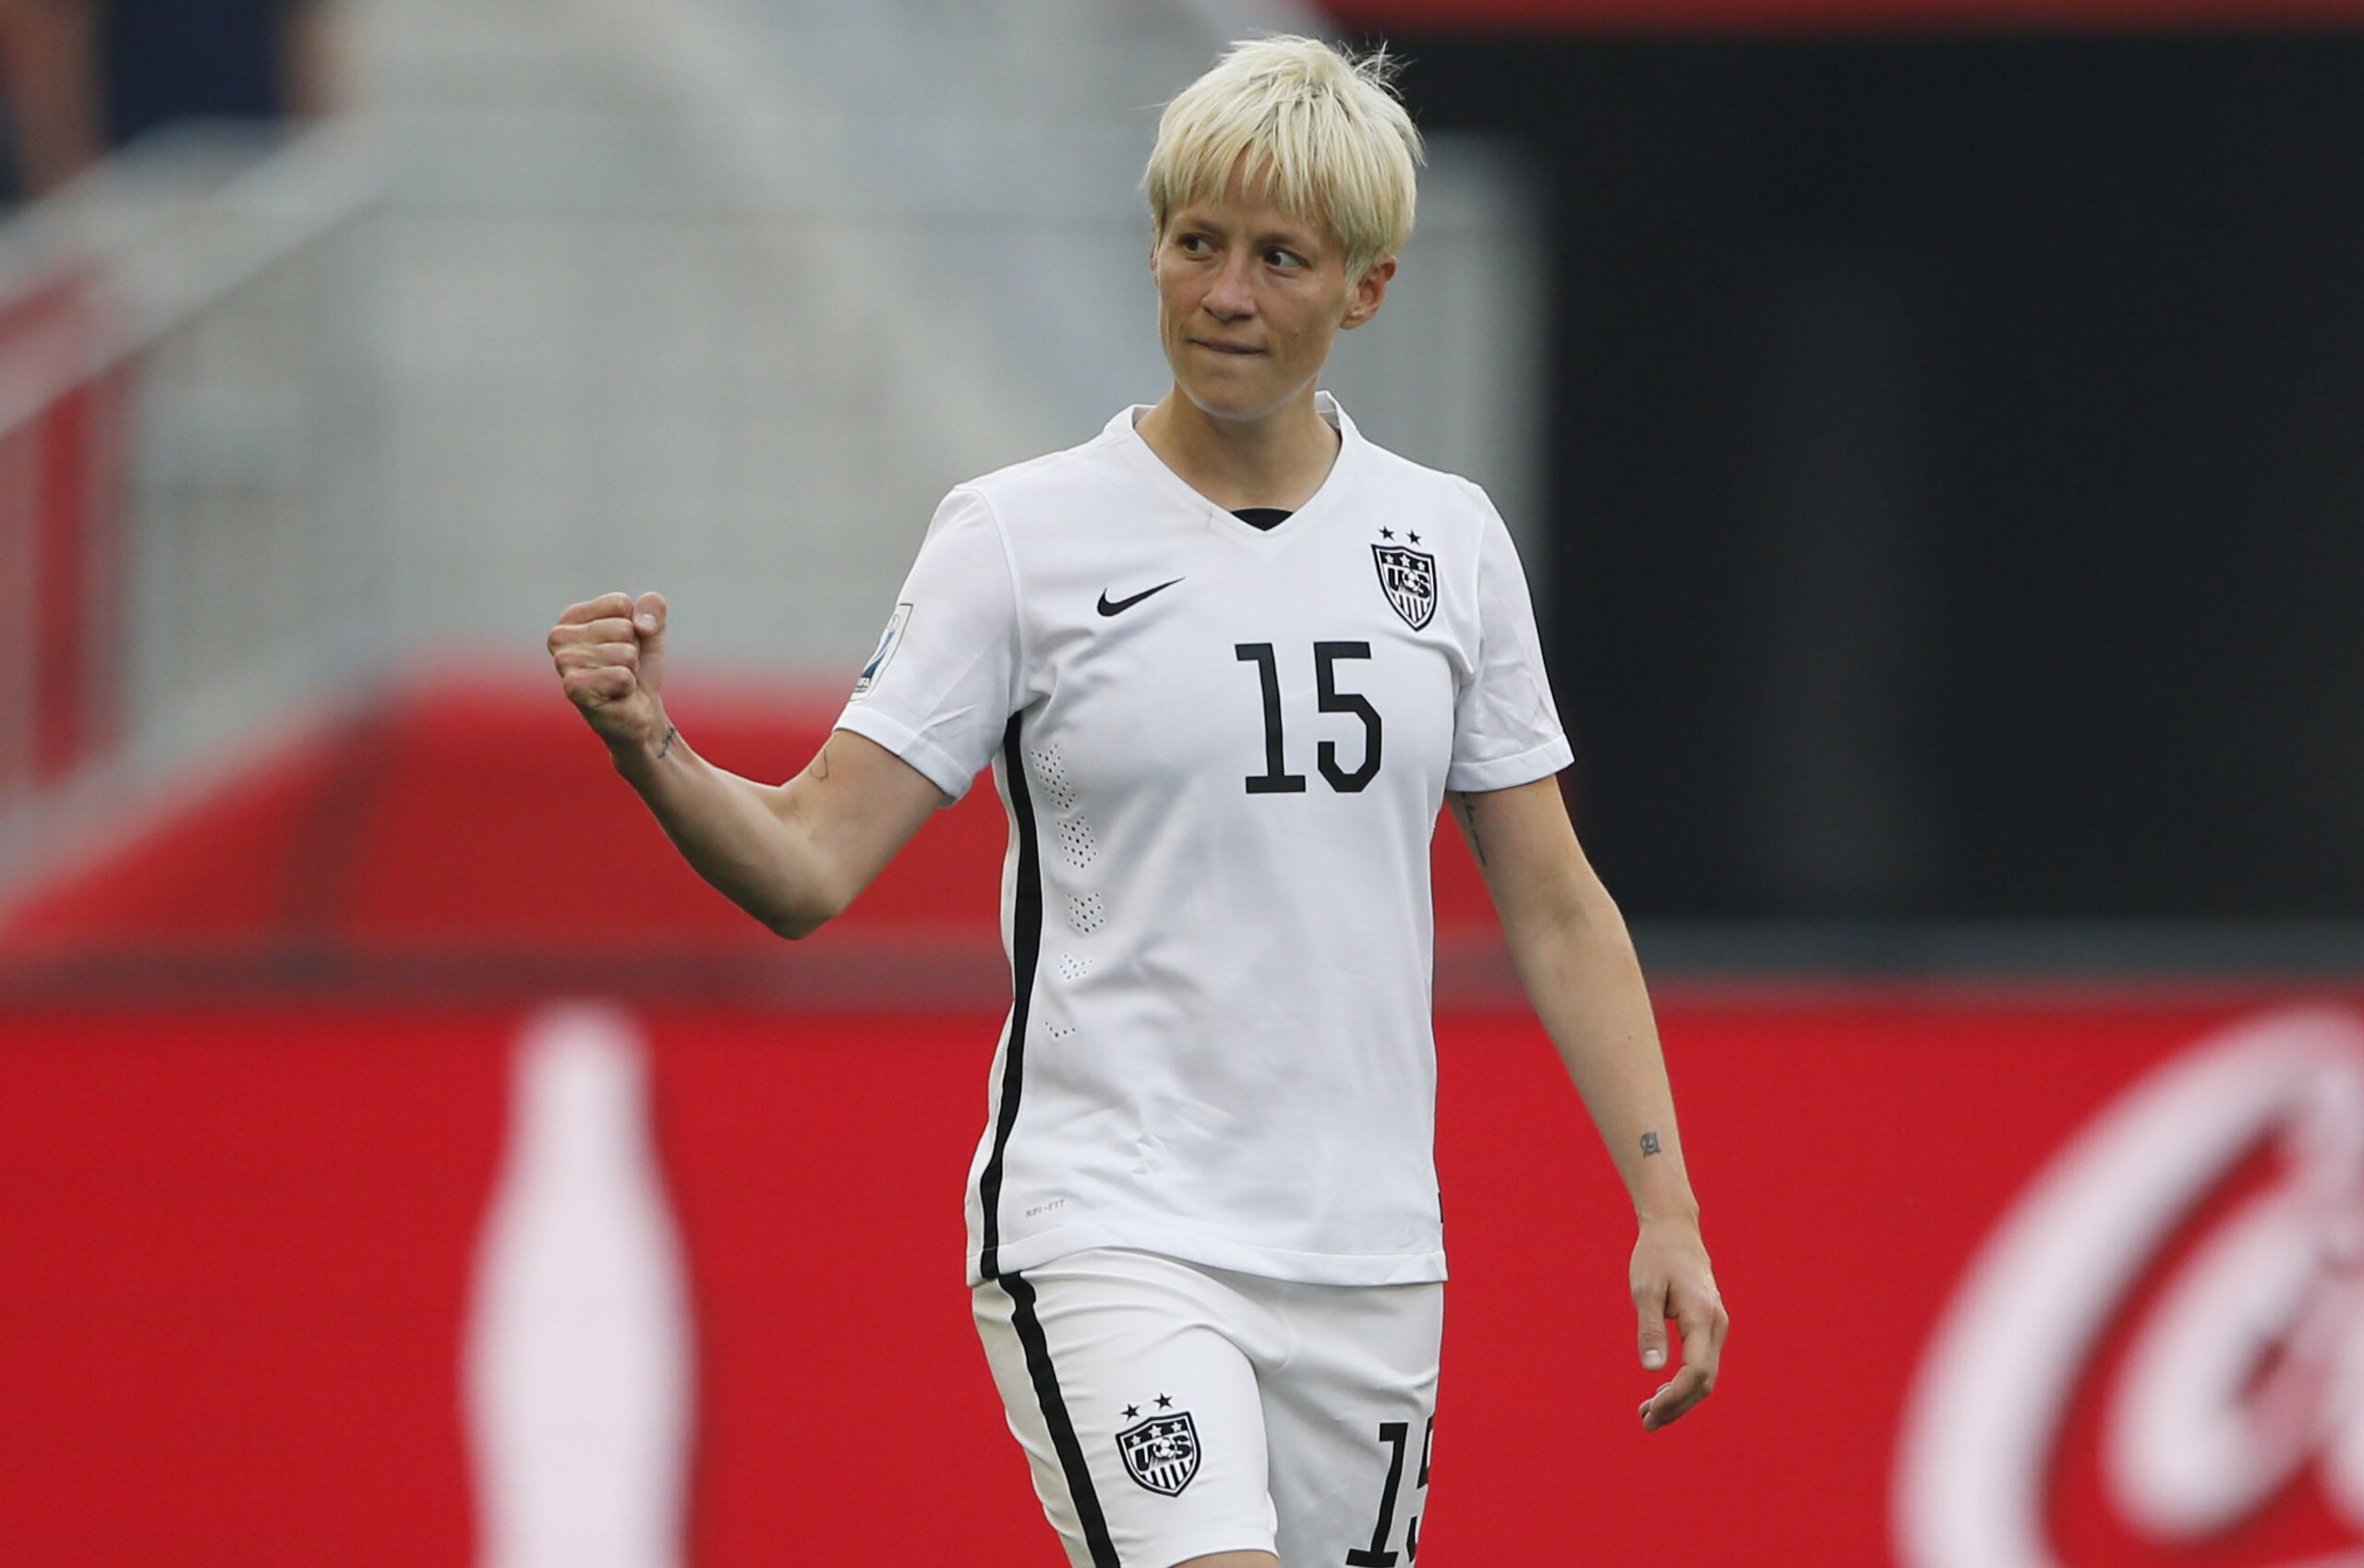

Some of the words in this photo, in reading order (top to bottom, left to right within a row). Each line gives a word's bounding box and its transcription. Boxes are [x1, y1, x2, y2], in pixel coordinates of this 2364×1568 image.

[1388, 568, 1430, 599] US
[1235, 641, 1382, 793] 15
[1134, 1434, 1192, 1472] US
